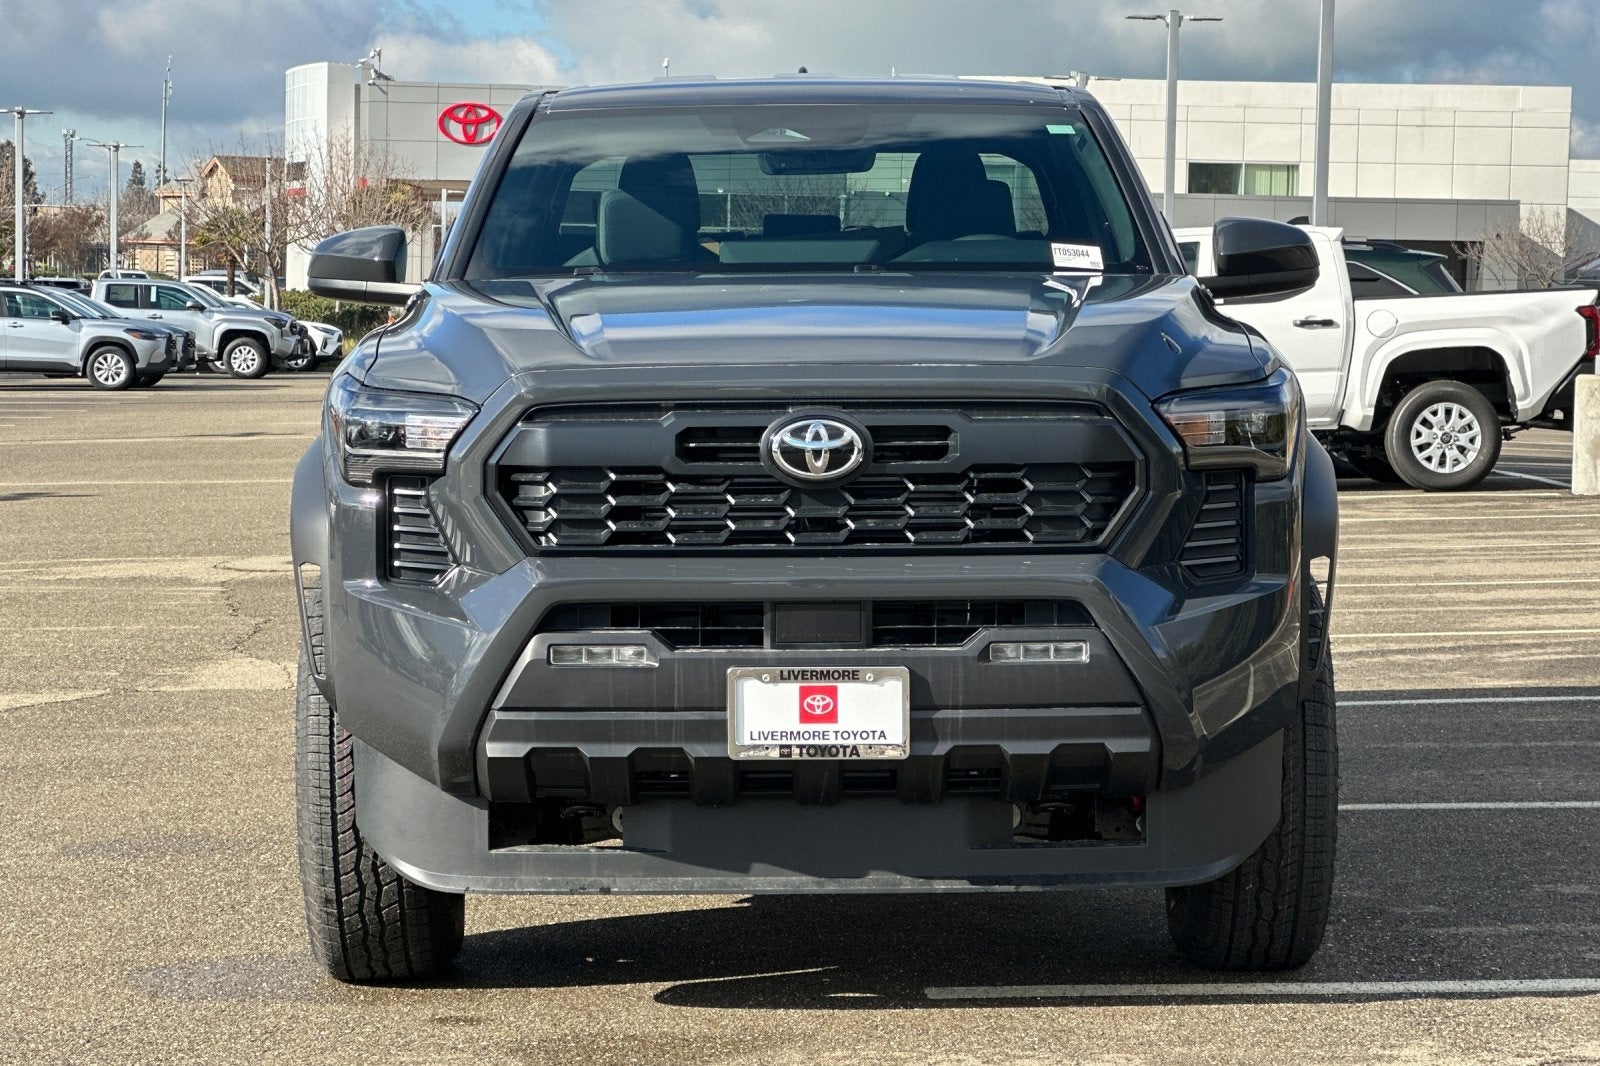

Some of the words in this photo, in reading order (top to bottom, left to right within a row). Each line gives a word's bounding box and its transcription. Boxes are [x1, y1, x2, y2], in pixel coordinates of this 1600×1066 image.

[779, 669, 860, 681] LIVERMORE
[750, 731, 830, 741] LIVERMORE
[833, 730, 887, 741] TOYOTA
[796, 744, 861, 758] TOYOTA
